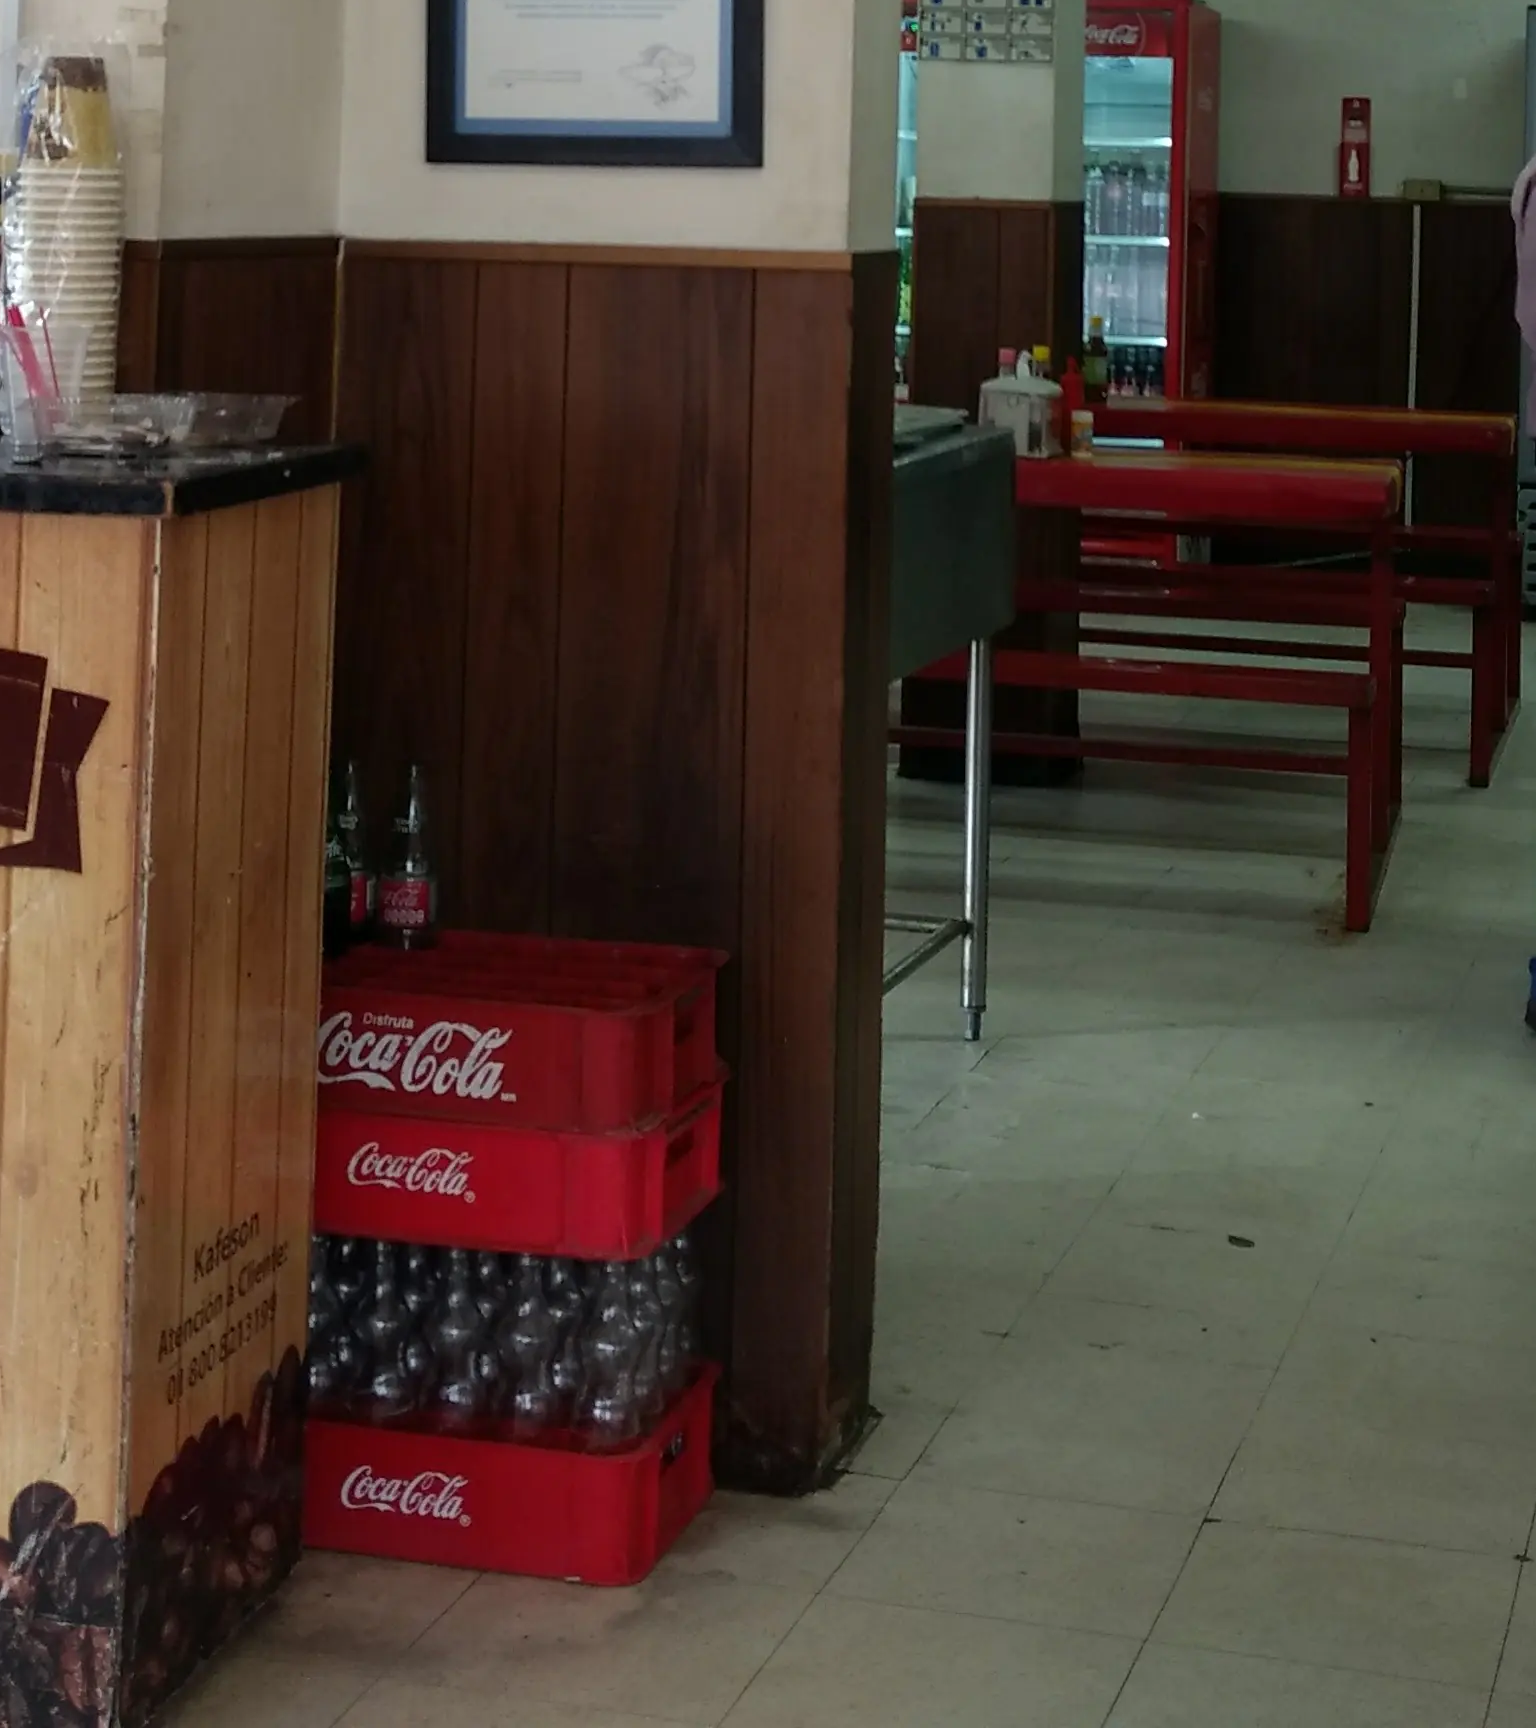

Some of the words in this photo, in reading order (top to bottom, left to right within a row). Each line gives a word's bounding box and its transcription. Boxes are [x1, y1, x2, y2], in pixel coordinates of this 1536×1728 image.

[363, 1012, 414, 1029] Disfruta
[317, 1011, 513, 1100] Coca-Cola
[347, 1141, 474, 1196] Coca-Cola
[341, 1465, 468, 1519] Coca-Cola
